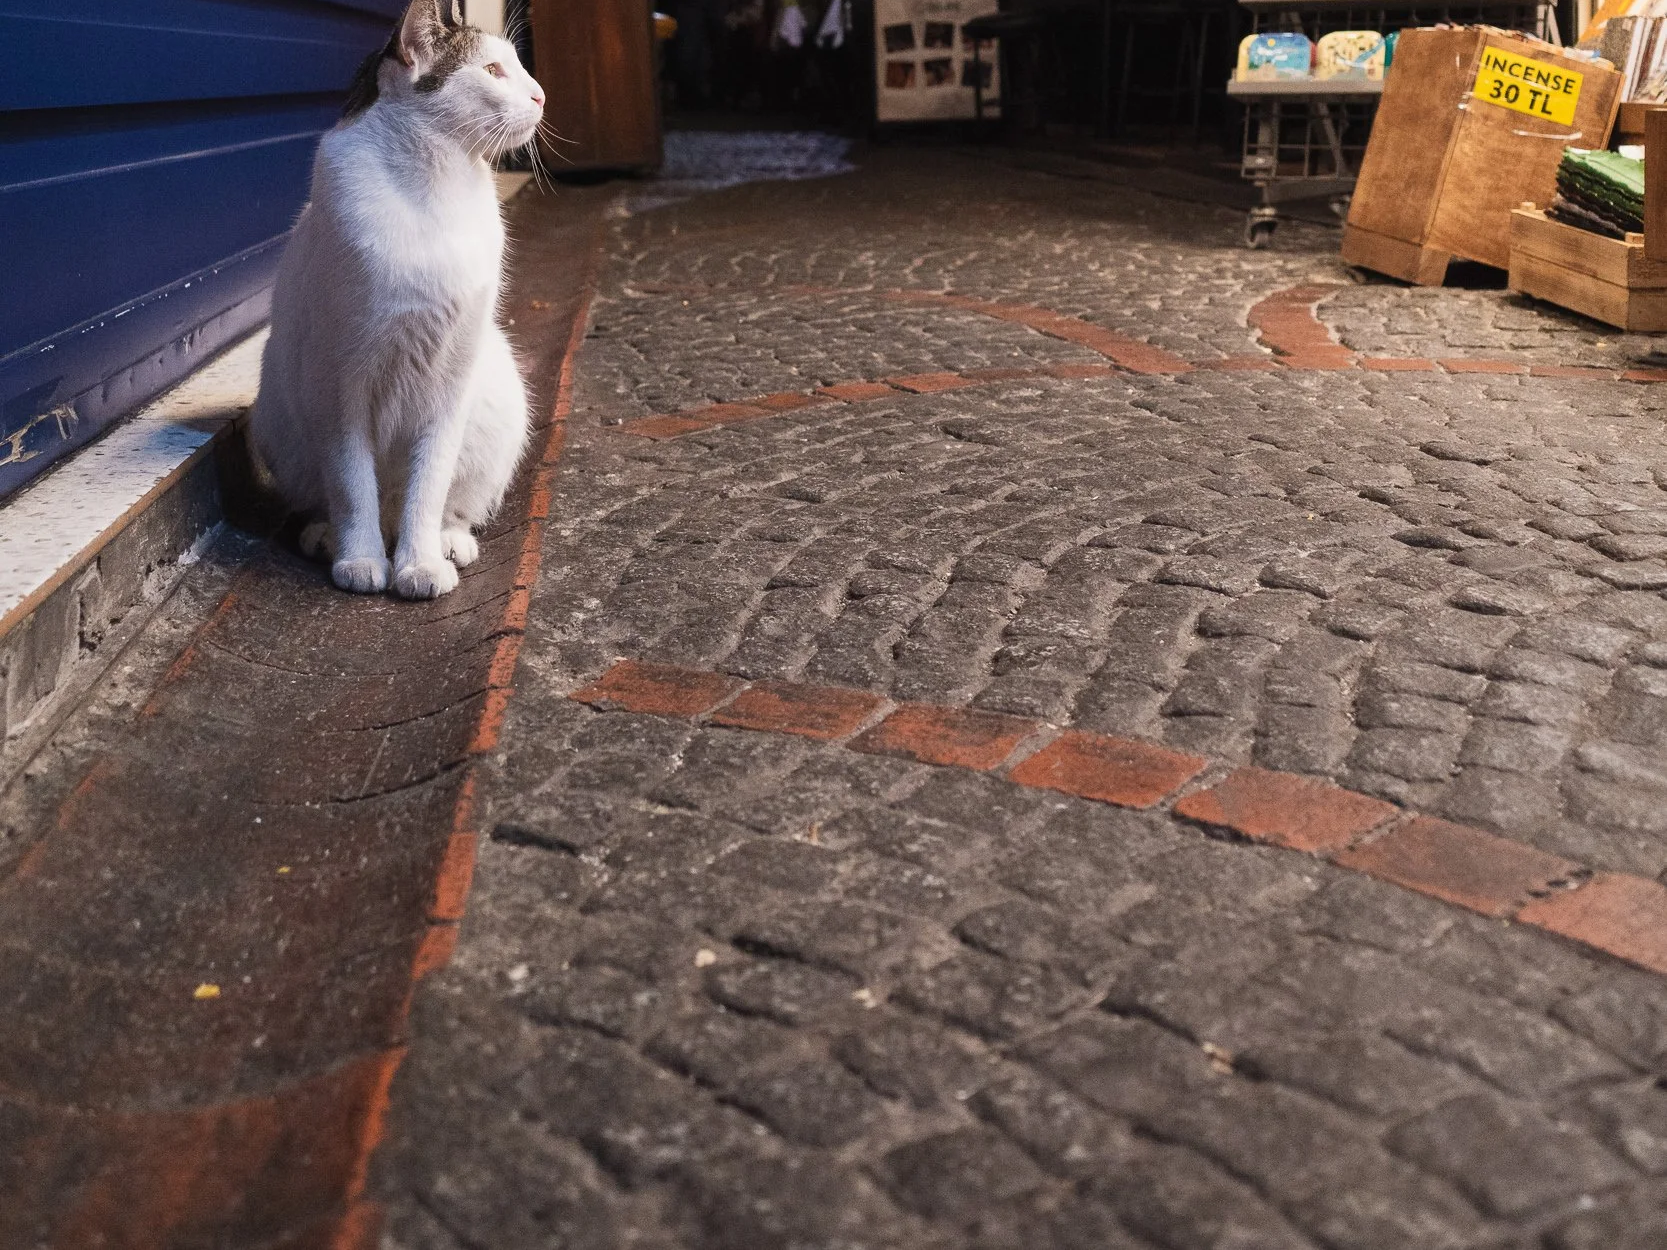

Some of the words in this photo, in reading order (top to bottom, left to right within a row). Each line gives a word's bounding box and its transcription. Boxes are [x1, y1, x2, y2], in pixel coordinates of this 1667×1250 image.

[1485, 54, 1576, 94] INCENSE
[1490, 79, 1520, 103] 30
[1529, 89, 1552, 115] TL
